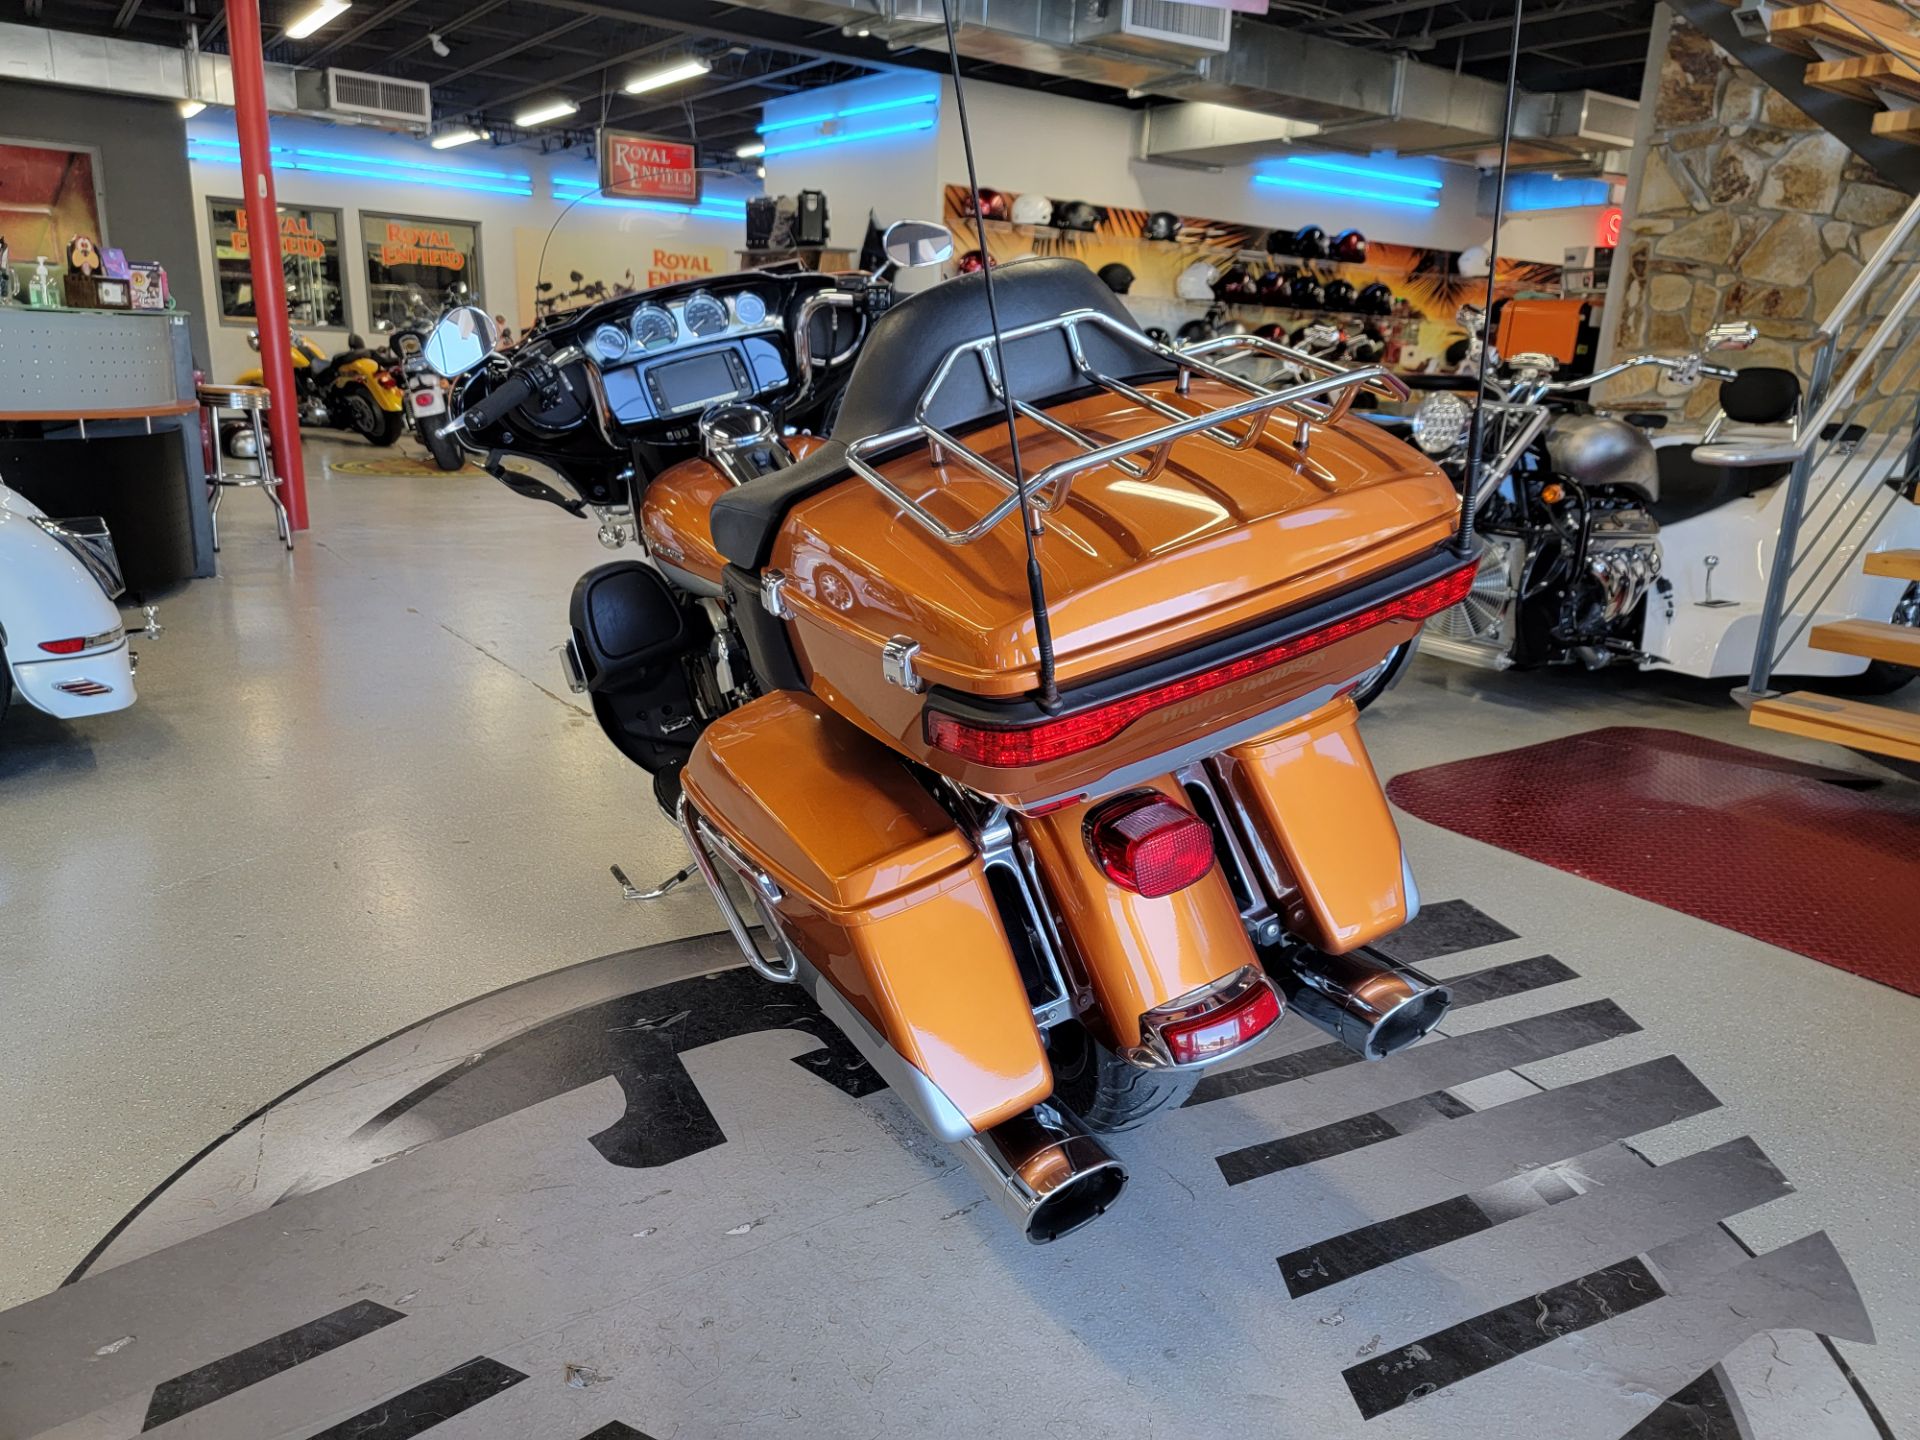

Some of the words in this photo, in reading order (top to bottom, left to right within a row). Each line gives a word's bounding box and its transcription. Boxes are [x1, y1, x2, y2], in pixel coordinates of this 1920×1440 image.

[615, 143, 671, 171] ROYAL
[629, 162, 691, 188] ENFIELD
[236, 208, 313, 236] RYAL
[231, 232, 325, 258] EELD
[386, 223, 455, 248] ROYAL
[381, 245, 465, 270] ENFIELD
[653, 249, 713, 273] ROYAL
[1161, 650, 1327, 723] HARLEY-DAVIDSON
